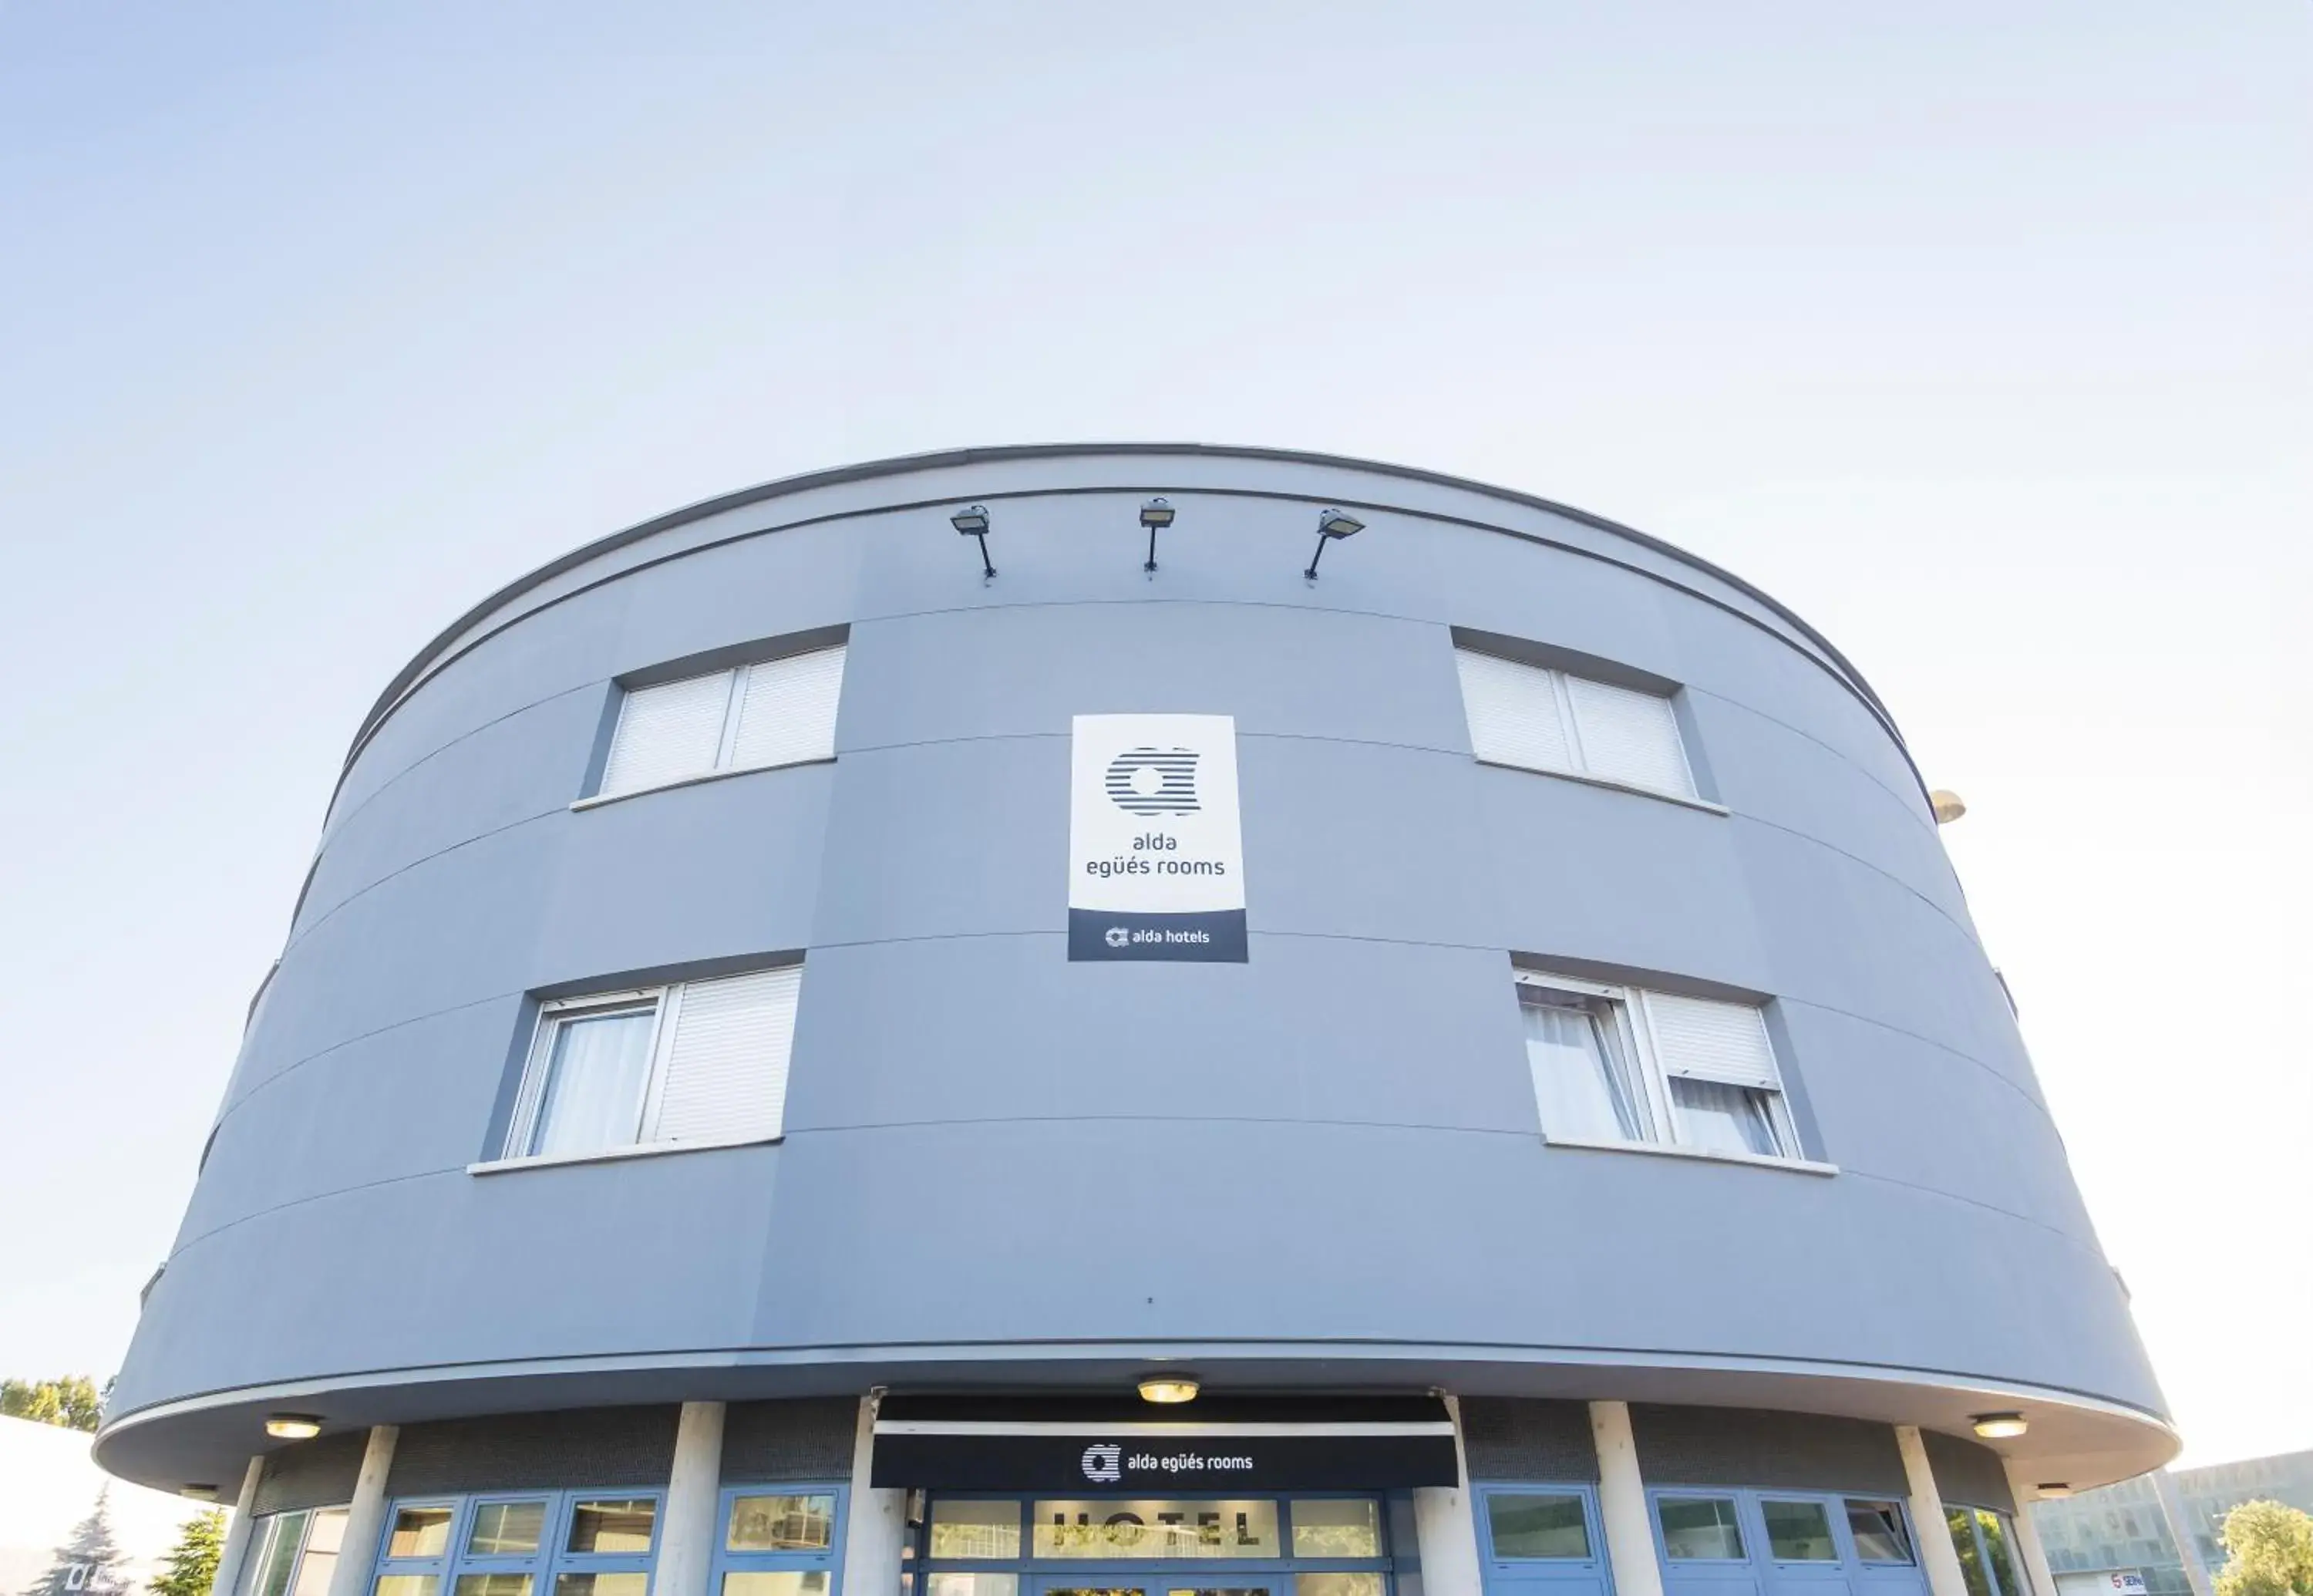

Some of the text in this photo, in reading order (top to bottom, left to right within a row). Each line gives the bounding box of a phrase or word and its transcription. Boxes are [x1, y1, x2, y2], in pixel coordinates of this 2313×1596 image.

[1133, 833, 1177, 850] alda
[1086, 856, 1225, 878] egüés rooms
[1133, 929, 1210, 942] alda hotels
[1127, 1453, 1253, 1473] alda egüés rooms
[1054, 1512, 1260, 1546] HOTEL
